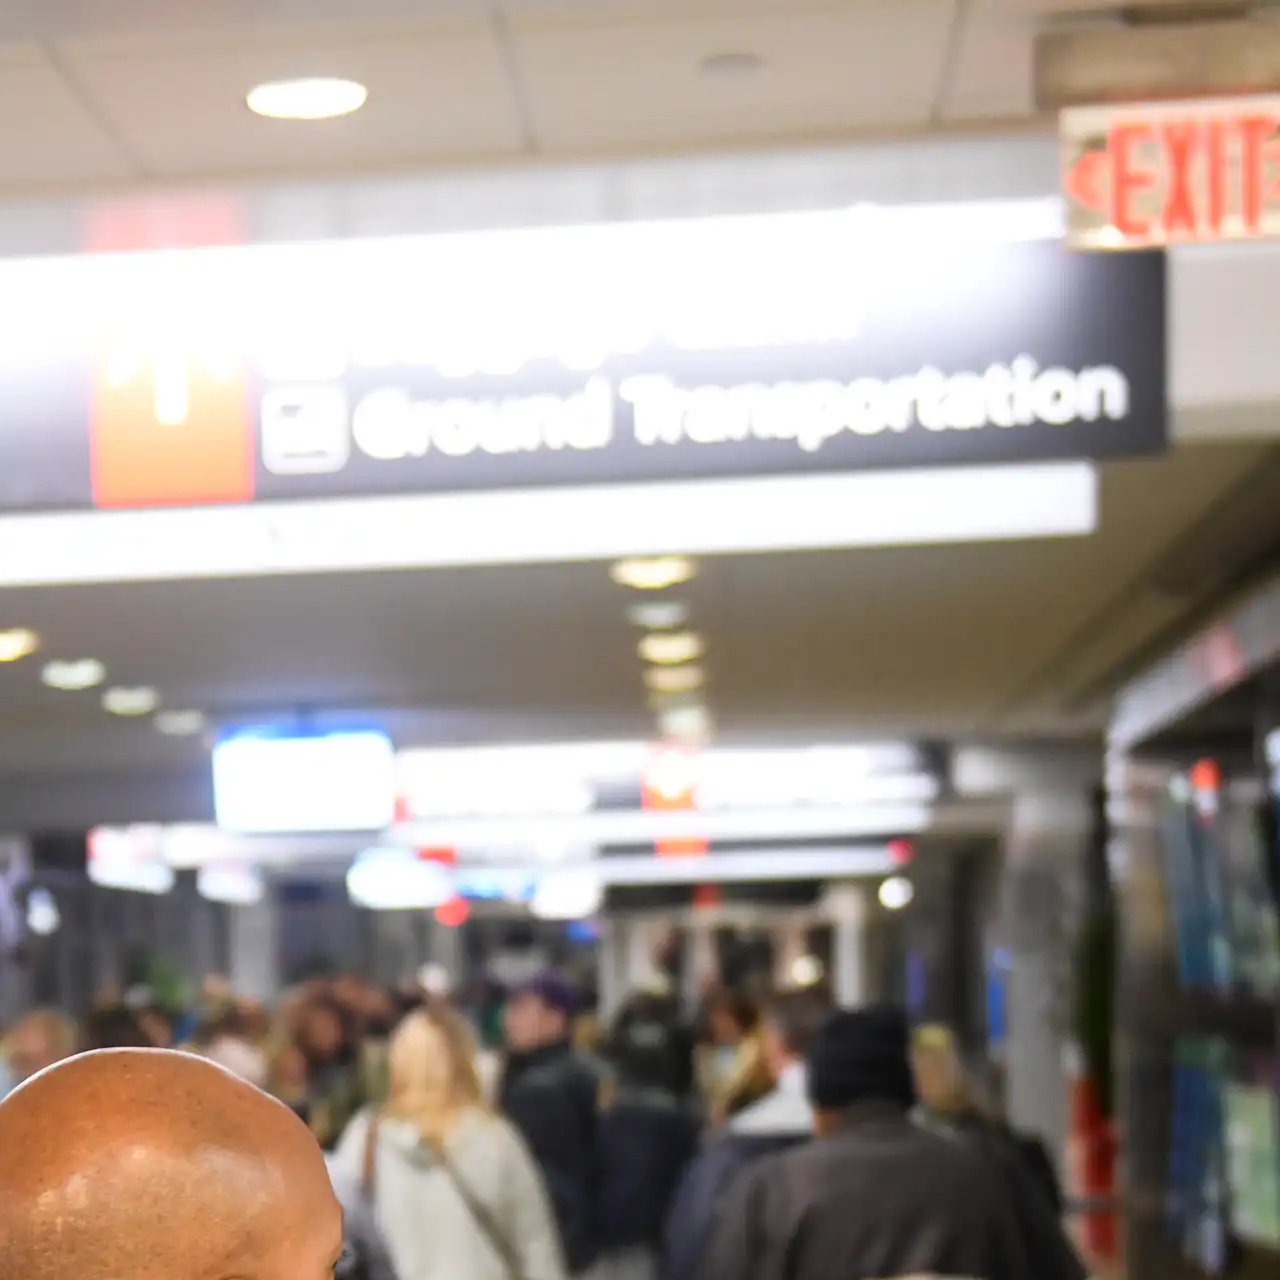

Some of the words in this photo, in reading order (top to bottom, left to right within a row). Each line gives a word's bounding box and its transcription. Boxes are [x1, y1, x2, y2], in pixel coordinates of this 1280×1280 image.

[1107, 115, 1278, 236] EXIT
[352, 376, 613, 457] Ground
[620, 354, 1126, 450] Transportation
